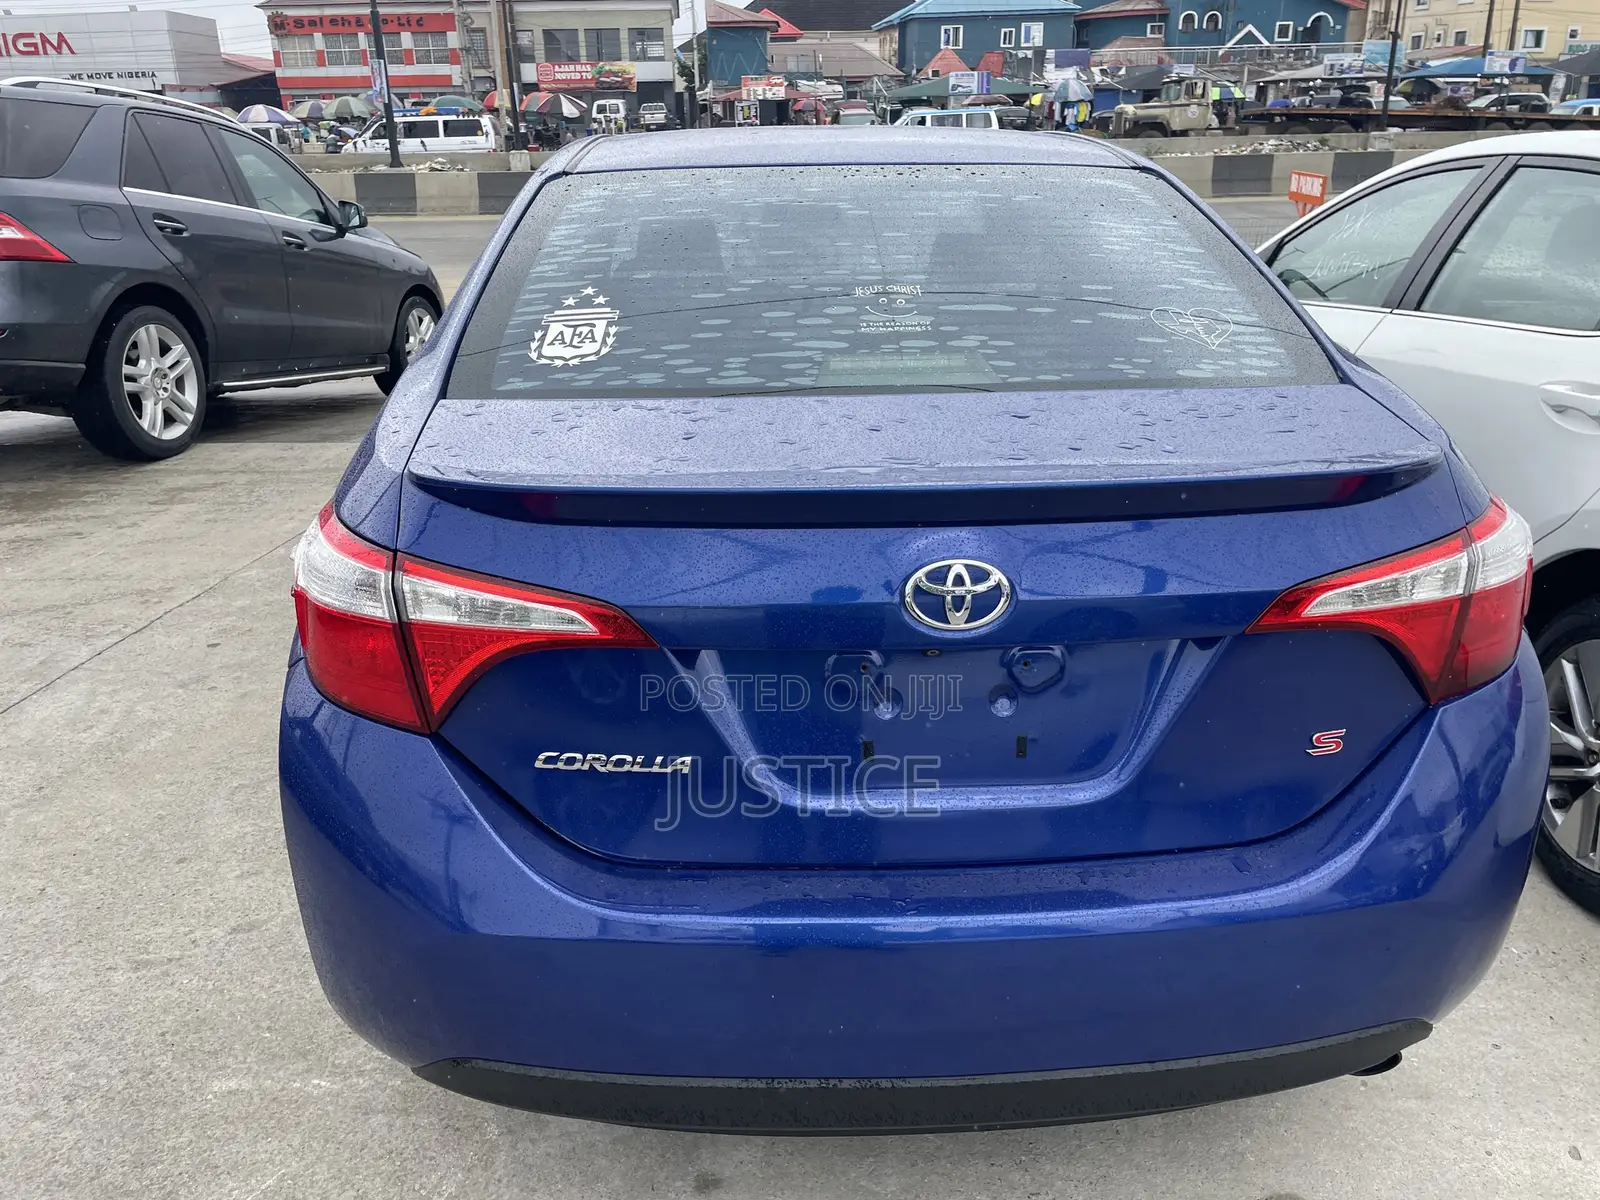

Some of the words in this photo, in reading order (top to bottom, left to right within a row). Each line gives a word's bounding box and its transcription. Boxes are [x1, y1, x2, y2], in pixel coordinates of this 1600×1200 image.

[0, 31, 77, 57] IGM
[87, 72, 114, 80] MOVE
[117, 71, 157, 79] NIGERIA
[554, 64, 575, 72] AJAH
[576, 64, 592, 72] HAS
[554, 72, 581, 80] MOVED
[581, 72, 593, 80] TO
[855, 285, 883, 297] JESUS
[886, 285, 921, 296] CHRIST
[547, 322, 598, 348] AFA
[1306, 728, 1346, 756] S
[534, 751, 692, 775] COROLLA
